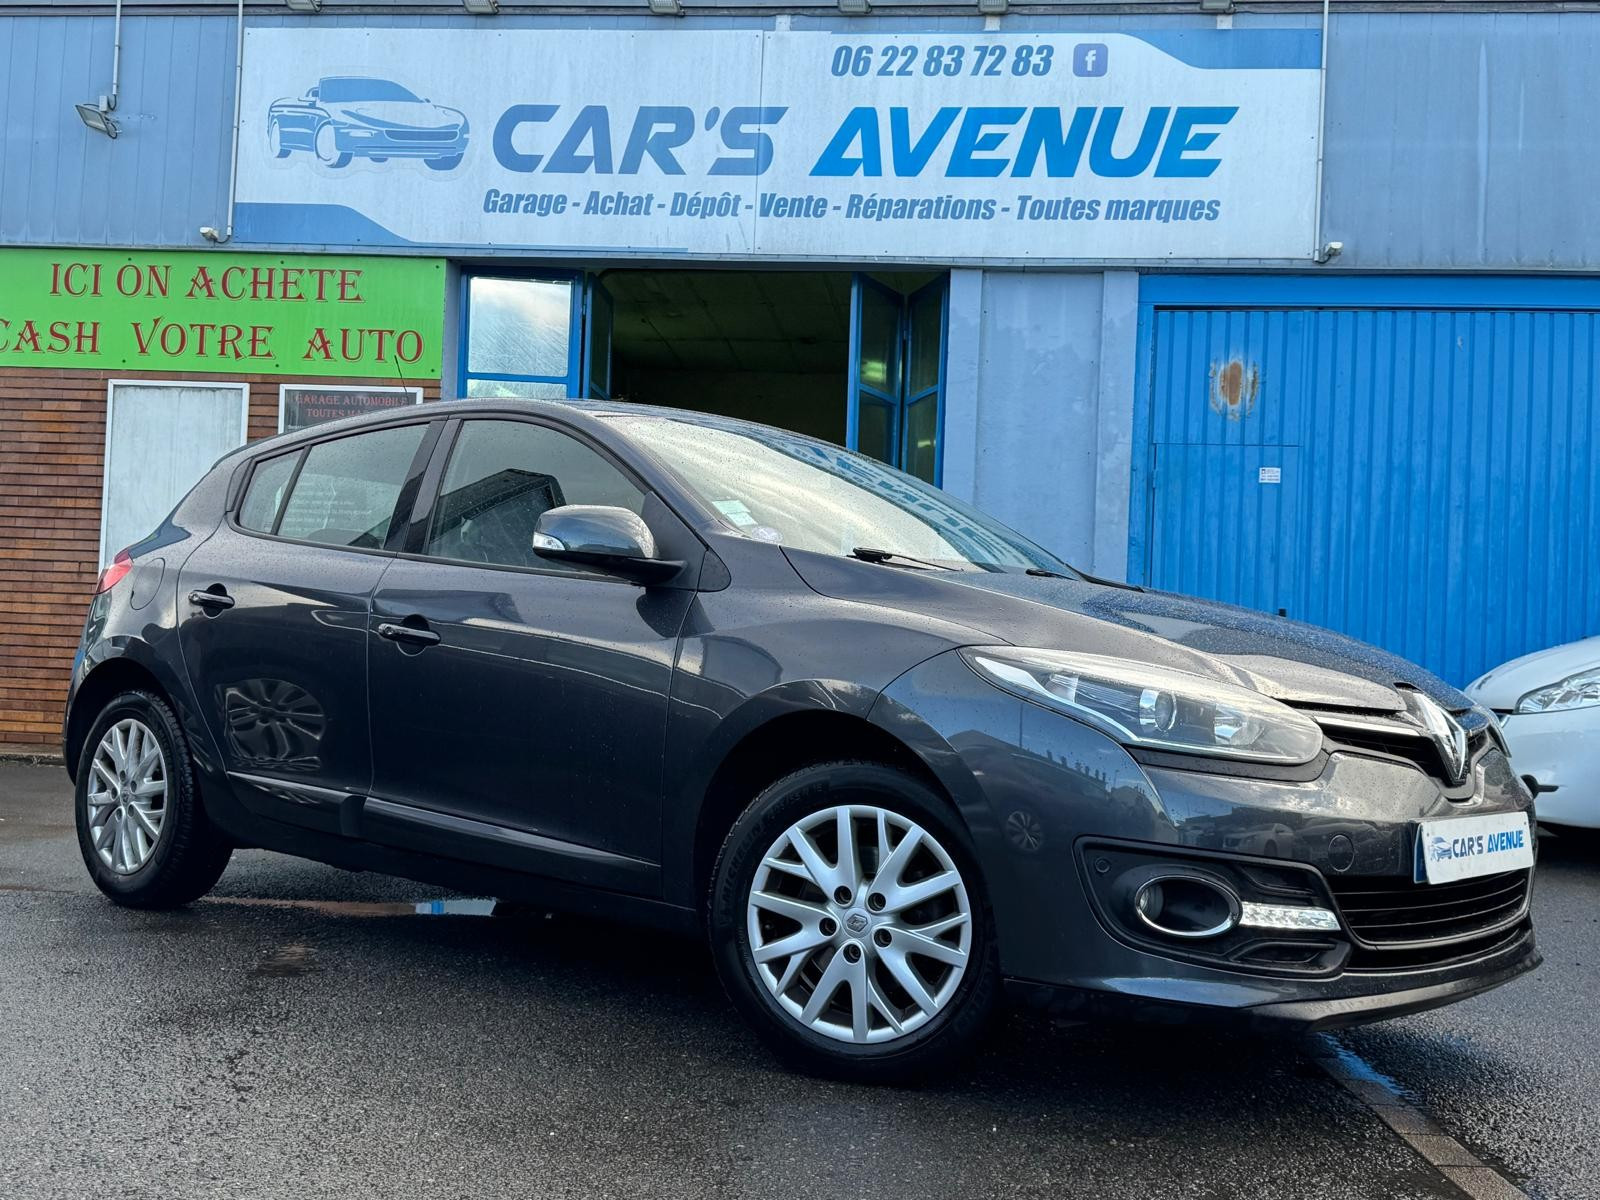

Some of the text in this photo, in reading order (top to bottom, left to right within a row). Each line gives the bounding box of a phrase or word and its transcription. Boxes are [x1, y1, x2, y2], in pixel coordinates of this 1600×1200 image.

[831, 45, 1054, 76] 06 22 83 72 83
[493, 104, 1239, 177] CAR'S AVENUE
[483, 189, 567, 217] Garage
[583, 190, 654, 216] Achat
[669, 191, 742, 219] Dépôt
[759, 193, 828, 218] Vente
[845, 193, 996, 221] Réparations
[1017, 195, 1101, 220] Toutes
[1105, 200, 1220, 223] marques
[50, 263, 364, 303] ICI ON ACHETE
[131, 316, 276, 361] VOTRE
[302, 327, 425, 363] AUTO
[295, 394, 341, 406] GARAGE
[306, 407, 345, 418] TOUTES
[1452, 830, 1524, 858] CAR'S AVENUE
